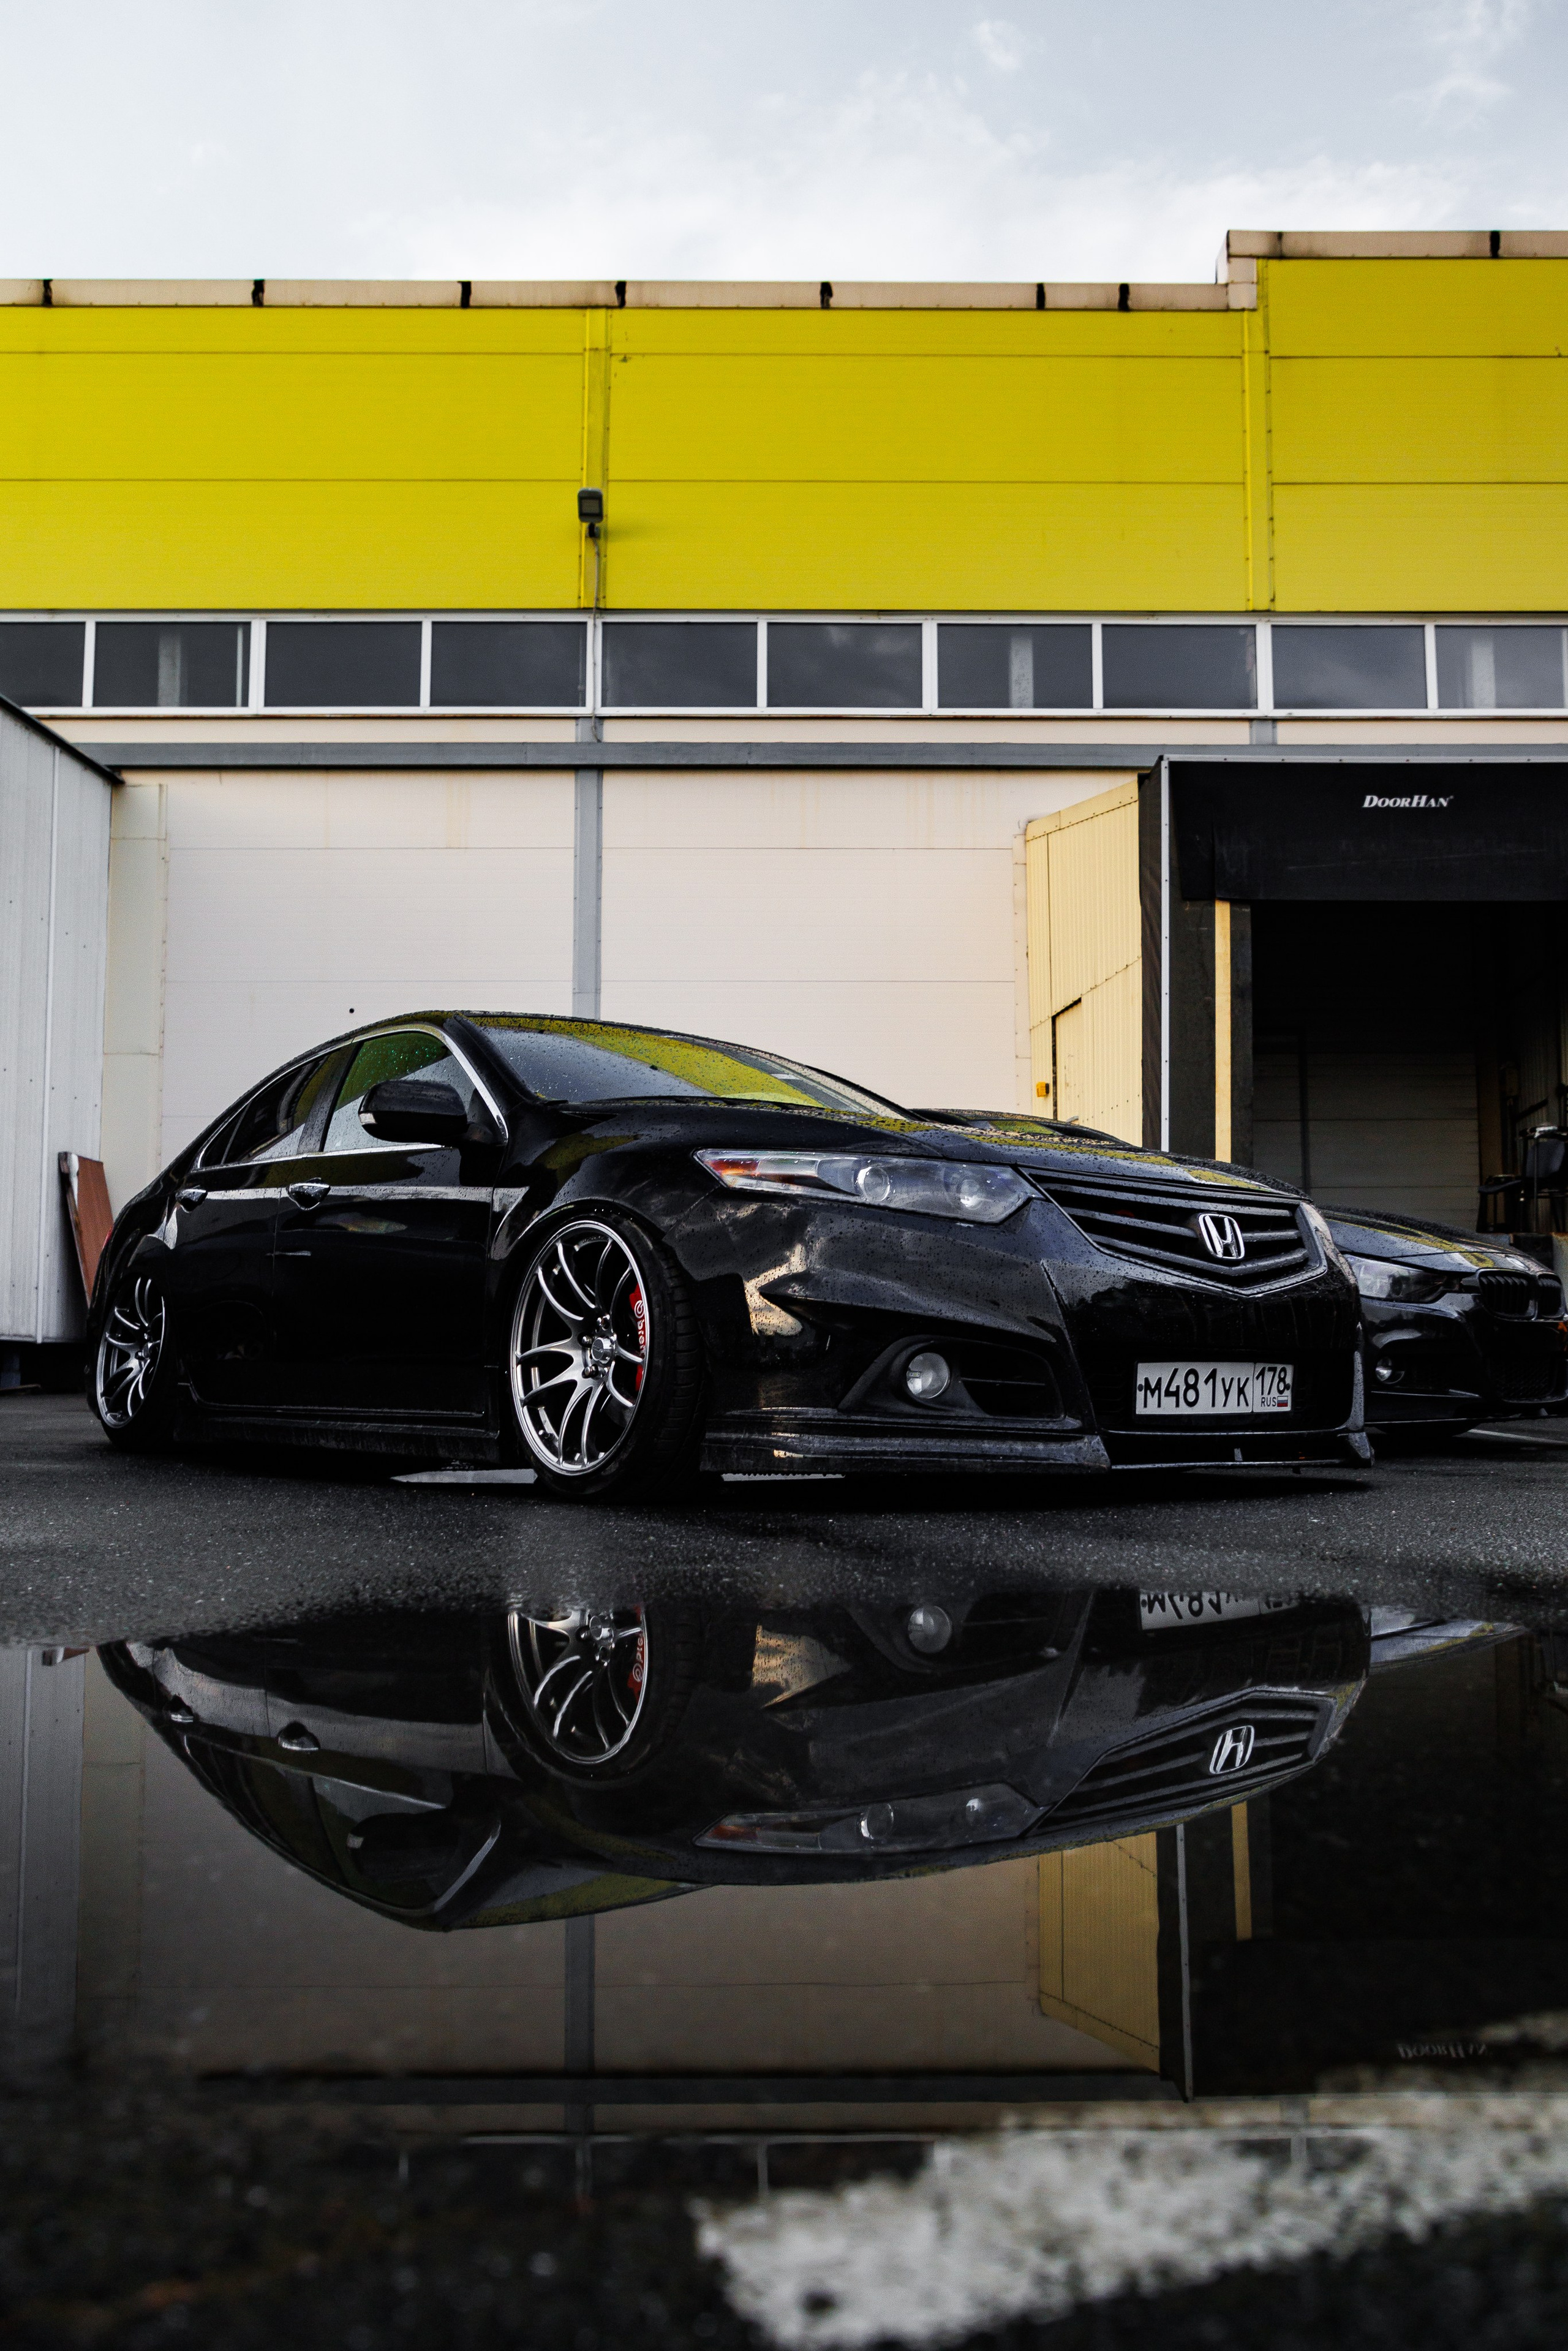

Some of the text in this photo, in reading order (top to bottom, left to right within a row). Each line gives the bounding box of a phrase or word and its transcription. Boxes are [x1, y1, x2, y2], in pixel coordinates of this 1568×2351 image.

[1143, 1366, 1287, 1408] М481УК 178
[1261, 1397, 1277, 1408] RUS
